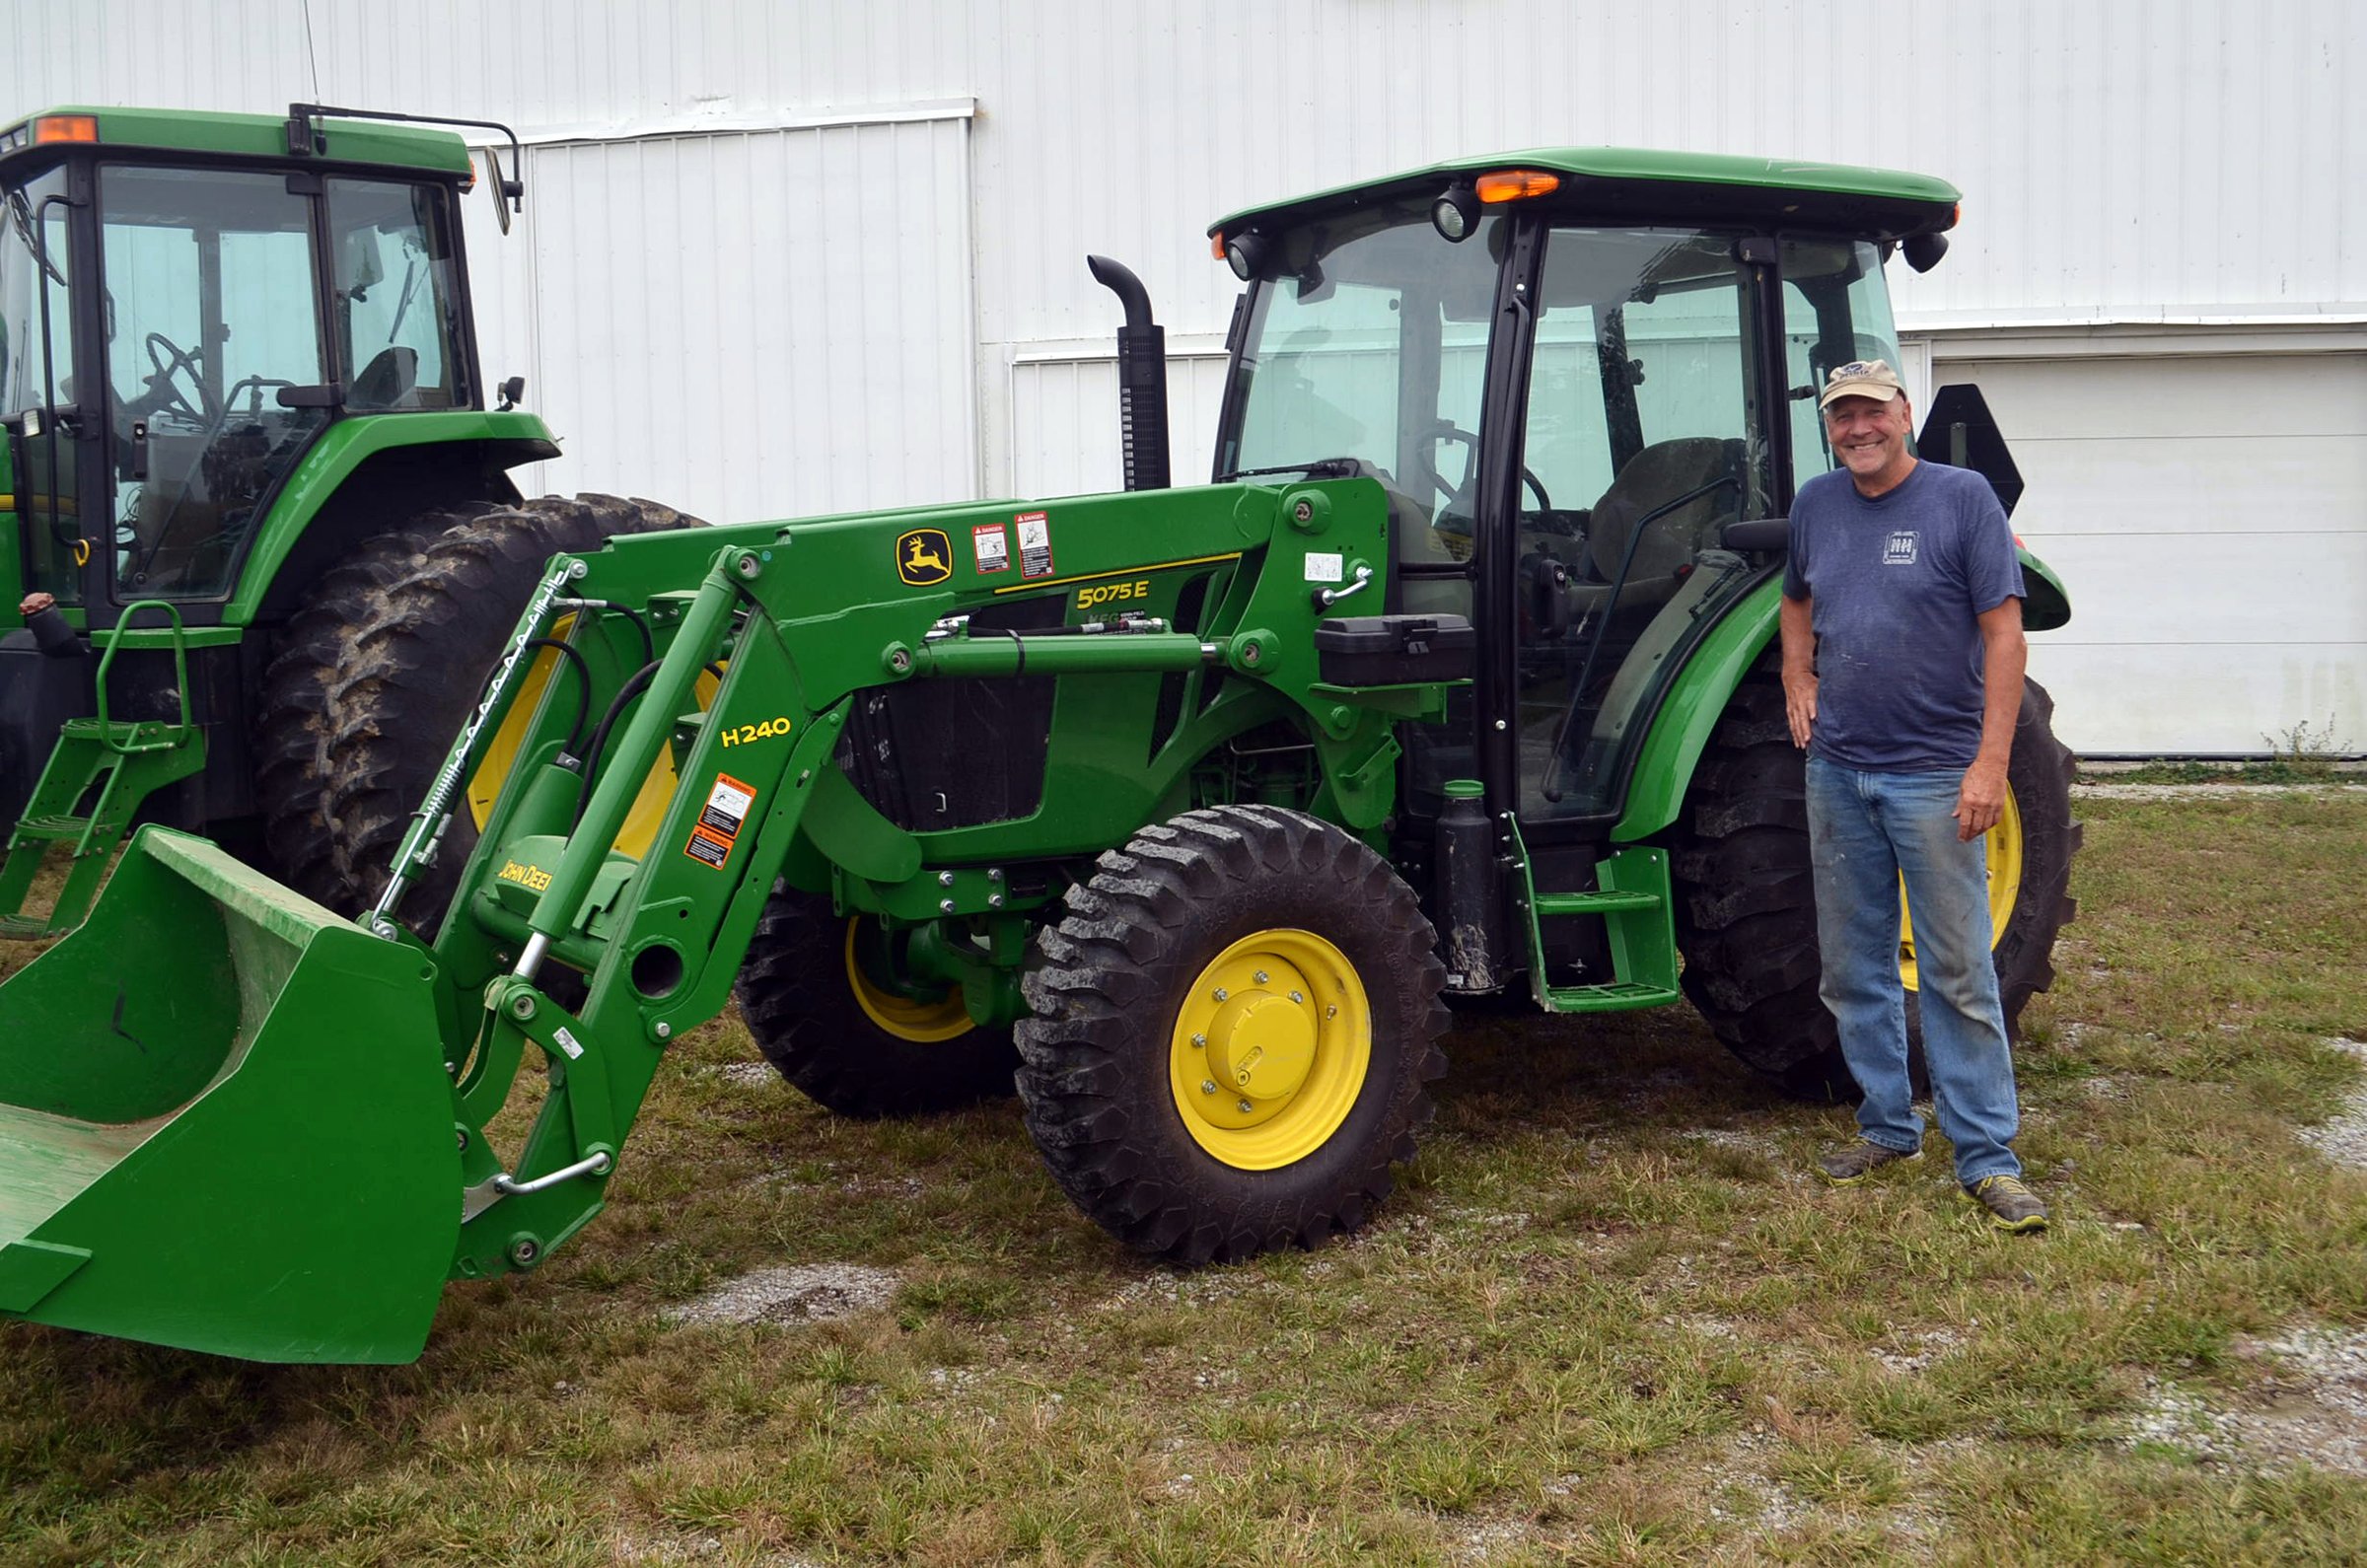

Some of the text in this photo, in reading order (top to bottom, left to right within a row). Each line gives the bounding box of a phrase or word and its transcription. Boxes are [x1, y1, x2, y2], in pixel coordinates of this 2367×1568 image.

[1023, 513, 1045, 522] DANGER
[721, 717, 791, 748] H240
[498, 859, 527, 883] JOHN
